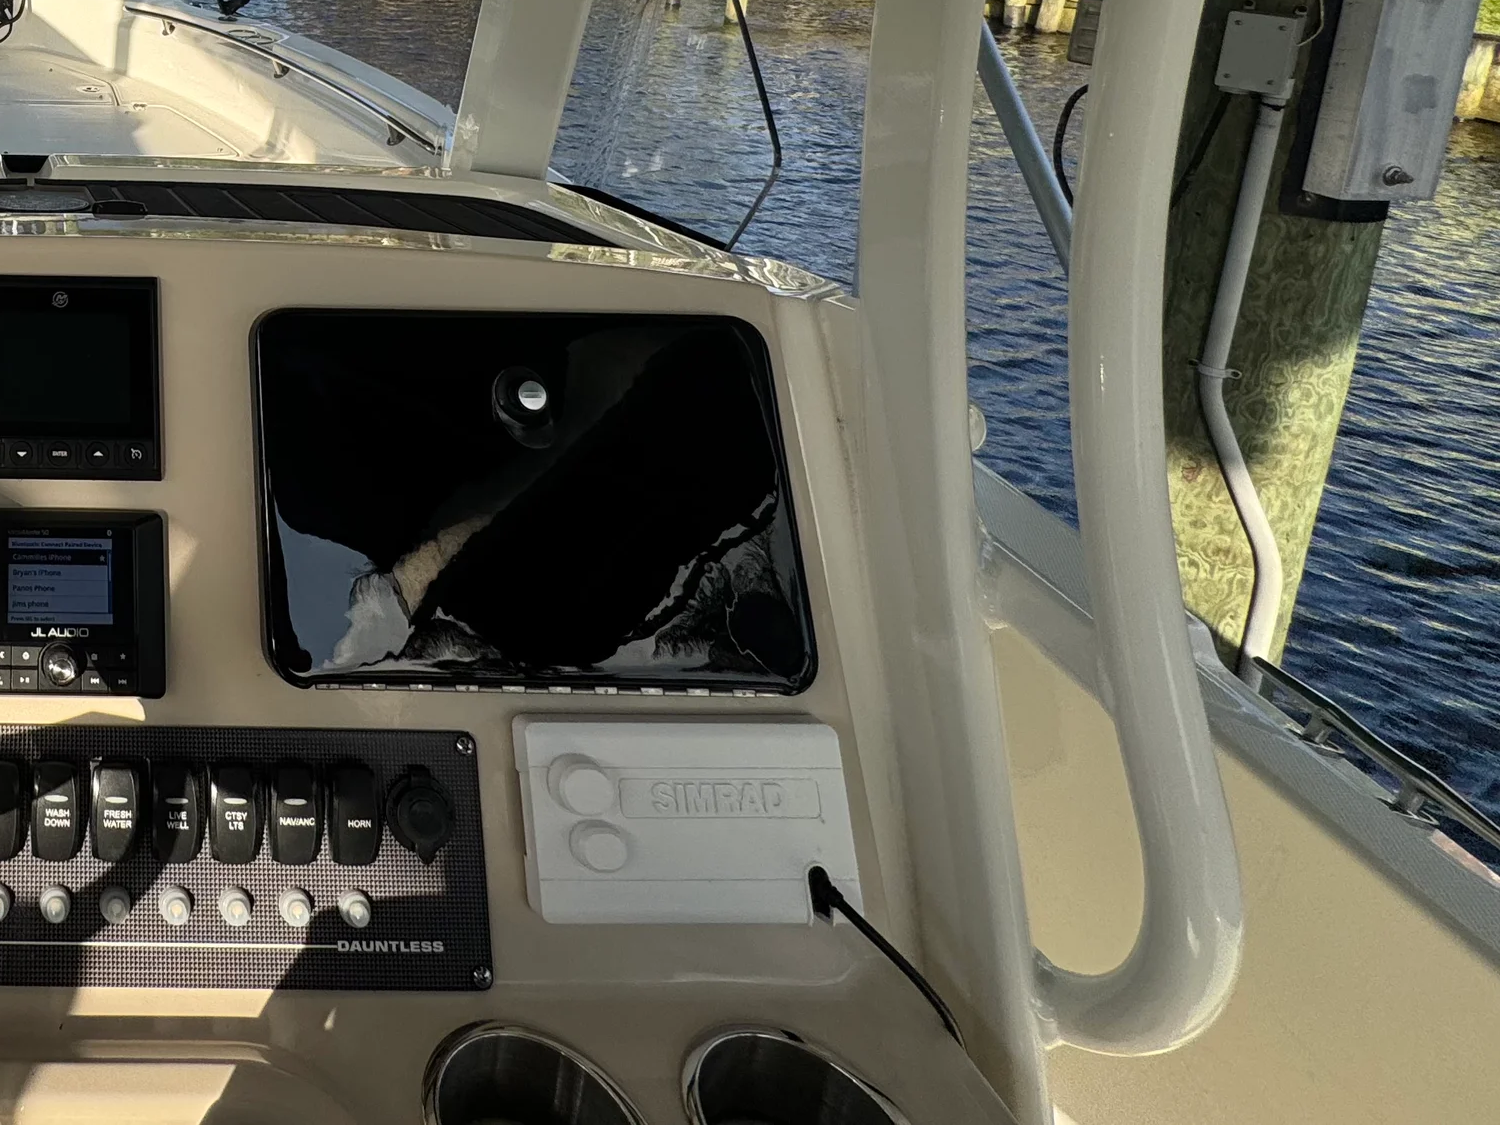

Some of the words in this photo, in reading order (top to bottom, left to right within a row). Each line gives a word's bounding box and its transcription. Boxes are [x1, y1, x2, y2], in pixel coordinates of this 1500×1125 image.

[30, 627, 47, 638] JL
[47, 627, 90, 638] AUDIO
[651, 781, 787, 815] SIMRAD
[45, 808, 70, 818] WASH
[103, 809, 132, 819] FRESH
[169, 811, 187, 820] LIVE
[225, 811, 248, 821] CTSY
[44, 818, 70, 827] DOWN
[103, 819, 132, 829] WATER
[167, 820, 189, 830] WELL
[228, 820, 244, 831] LTS
[279, 816, 315, 826] NAV/ANC
[348, 819, 372, 828] HORN
[337, 940, 444, 953] DAUNTLESS
